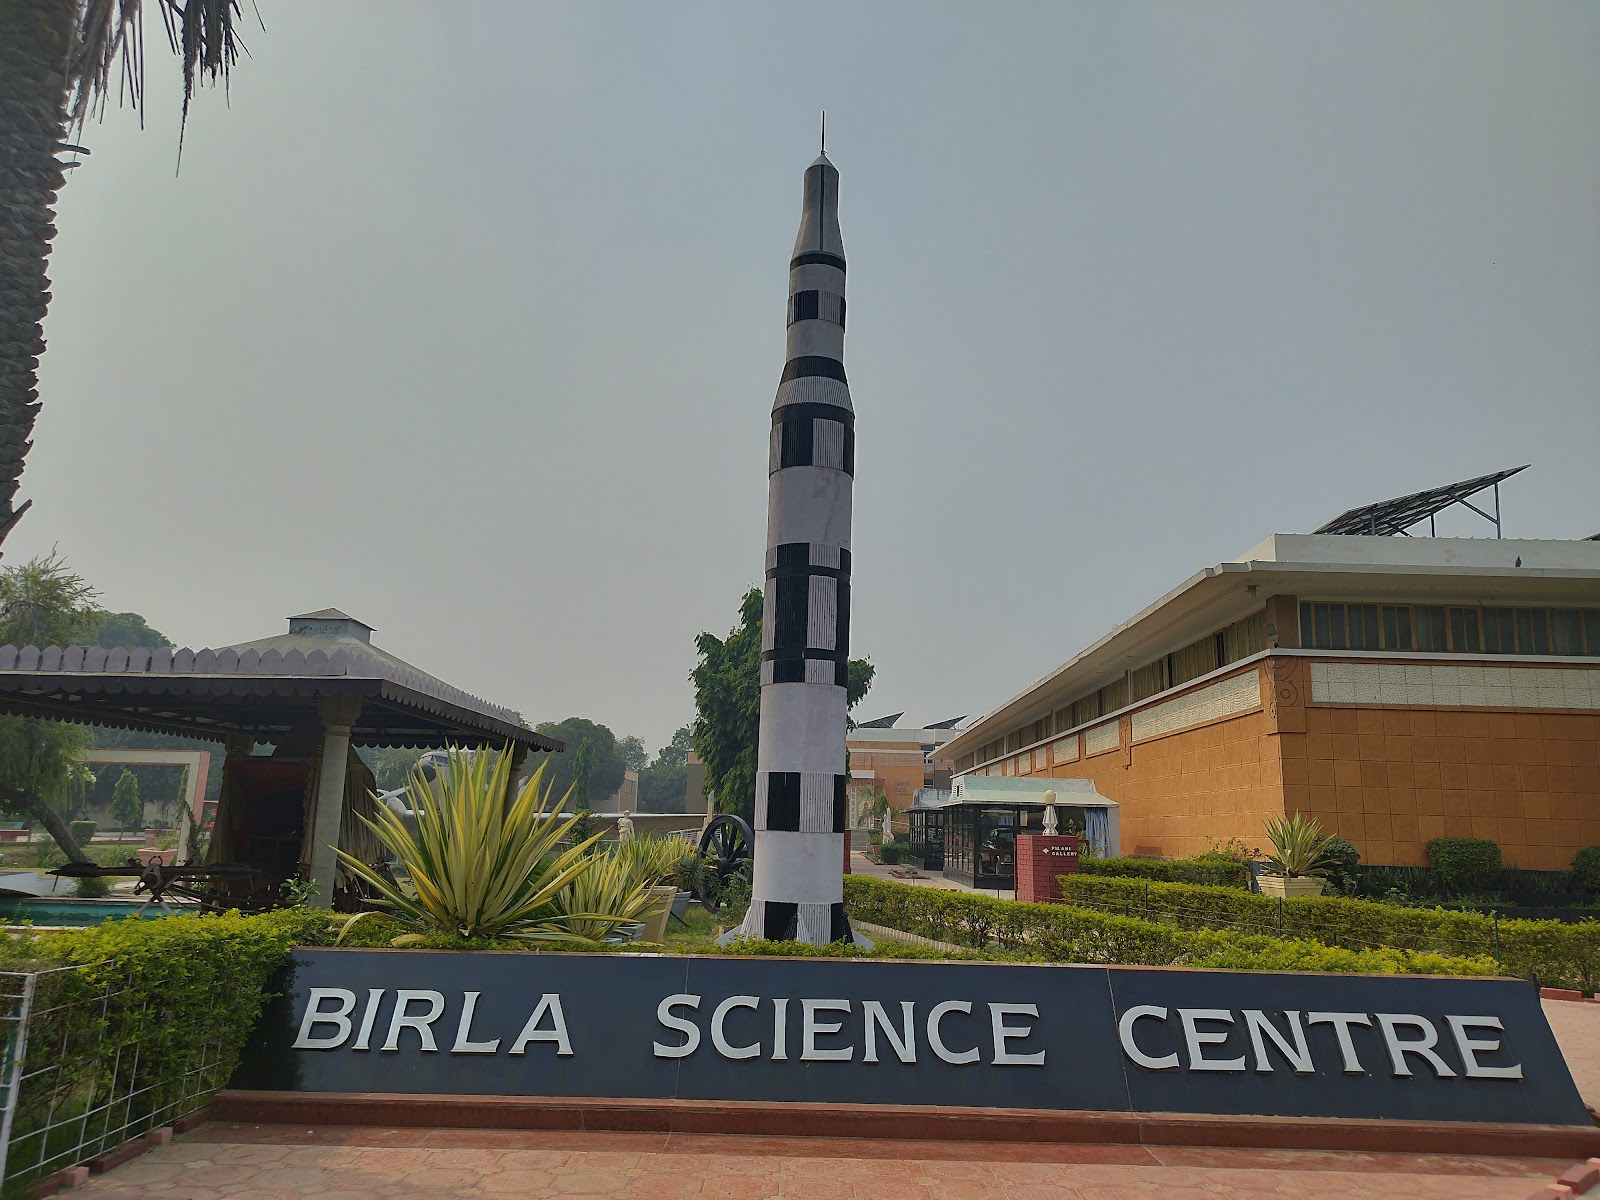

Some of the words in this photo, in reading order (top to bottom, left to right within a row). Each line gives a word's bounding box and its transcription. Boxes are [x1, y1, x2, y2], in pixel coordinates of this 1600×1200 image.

[291, 987, 574, 1056] BIRLA
[653, 993, 1047, 1067] SCIENCE
[1118, 1004, 1524, 1080] CENTRE
